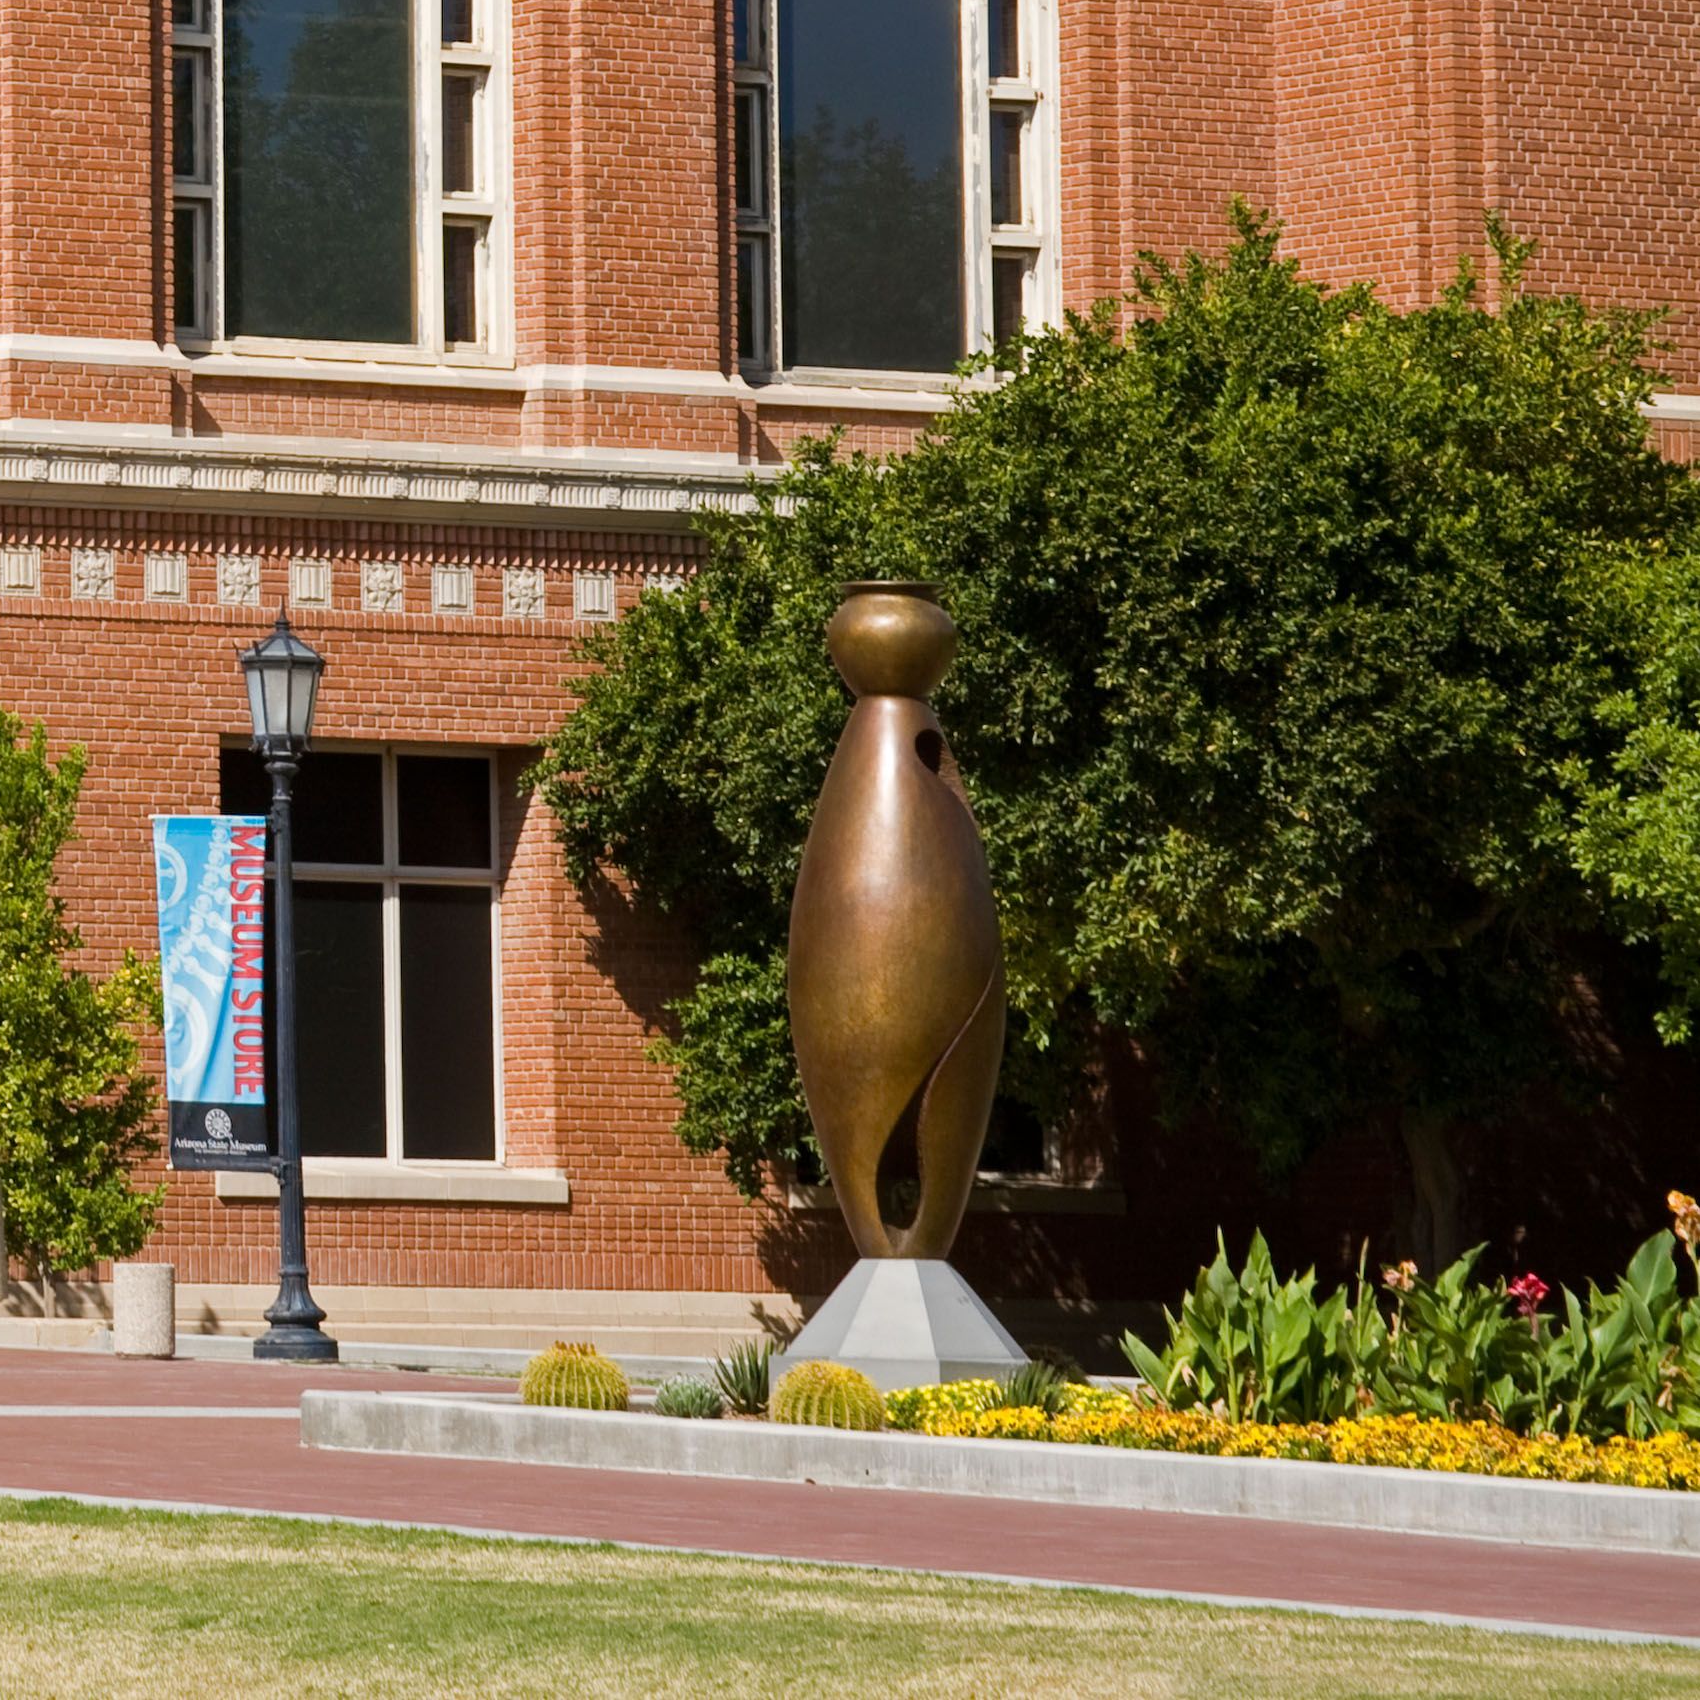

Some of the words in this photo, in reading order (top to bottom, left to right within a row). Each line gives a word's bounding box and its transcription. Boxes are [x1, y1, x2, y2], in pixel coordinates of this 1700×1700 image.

[230, 825, 266, 979] MUSEUM
[231, 988, 265, 1097] STORE
[174, 1137, 207, 1149] Arizona
[208, 1138, 229, 1150] State
[230, 1138, 267, 1152] Museum
